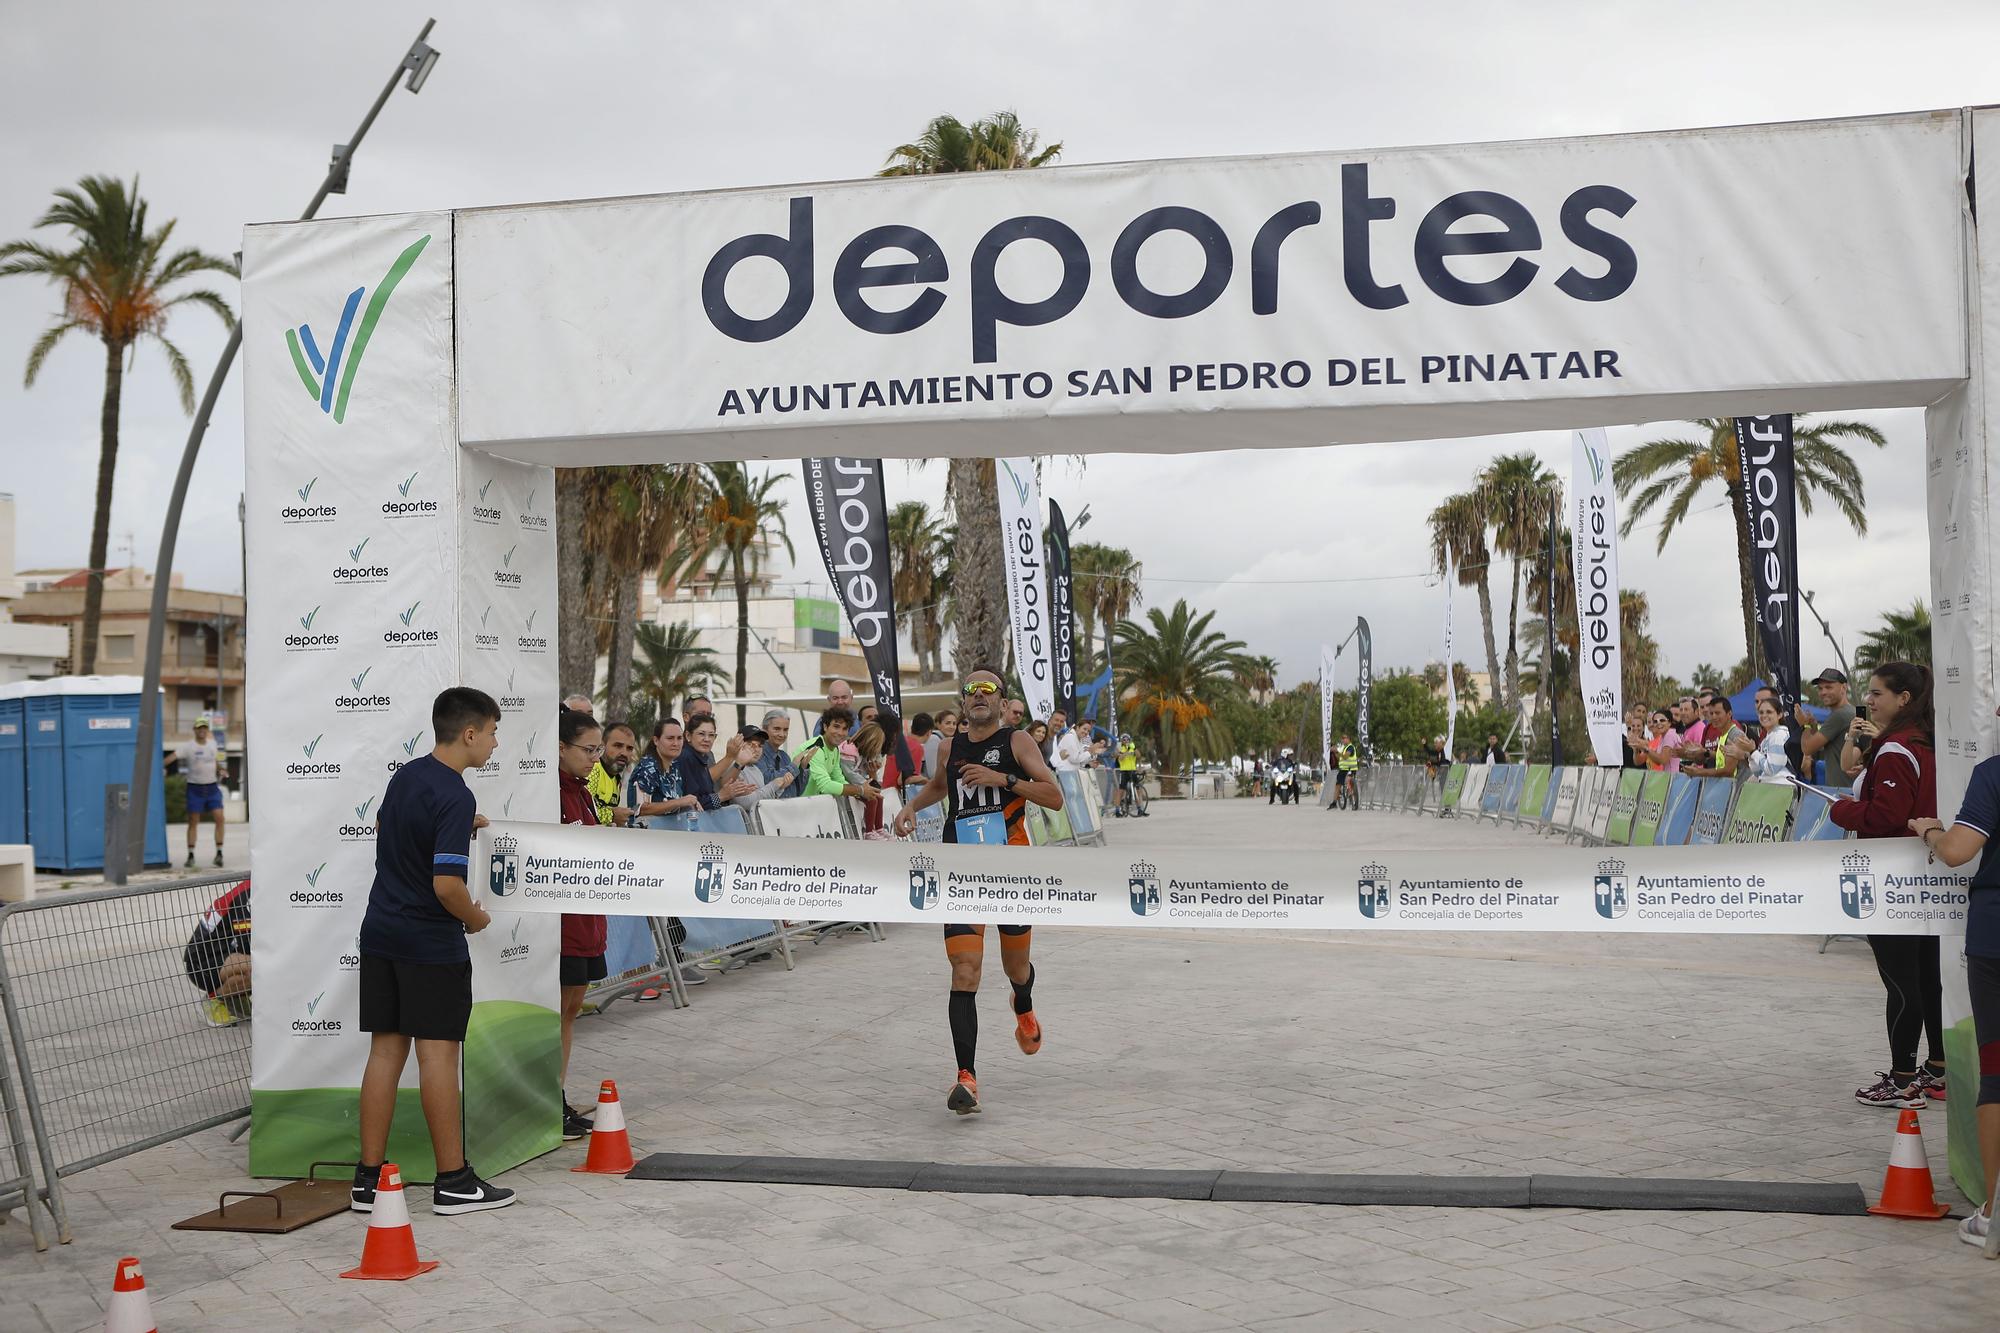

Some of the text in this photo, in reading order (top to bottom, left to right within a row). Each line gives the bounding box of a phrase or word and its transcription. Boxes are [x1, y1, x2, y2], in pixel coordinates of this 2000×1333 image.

[701, 163, 1638, 363] deportes
[717, 350, 1623, 416] AYUNTAMIENTO SAN PEDRO DEL PINATAR
[282, 505, 336, 519] deportes
[382, 500, 437, 515] deportes
[473, 505, 501, 519] deportes
[520, 513, 547, 526] deportes
[333, 565, 388, 580] deportes
[494, 570, 522, 585] deportes
[284, 634, 339, 648] deportes
[384, 630, 438, 644] deportes
[518, 636, 547, 649] deportes
[335, 695, 390, 709] deportes
[500, 696, 525, 708] deportes
[286, 762, 341, 776] deportes
[518, 758, 547, 771] deportes
[977, 826, 984, 842] 1
[525, 856, 634, 870] Ayuntamiento de
[734, 863, 846, 878] Ayuntamiento de
[525, 872, 664, 887] San Pedro del Pinatar
[948, 871, 1062, 886] Ayuntamiento de
[1169, 879, 1289, 891] Ayuntamiento de
[1400, 878, 1523, 891] Ayuntamiento de
[1636, 875, 1765, 891] Ayuntamiento de
[732, 879, 878, 895] San Pedro del Pinatar
[948, 886, 1097, 902] San Pedro del Pinatar
[290, 890, 343, 904] deportes
[574, 890, 585, 899] de
[589, 890, 631, 901] Deportes
[783, 896, 795, 906] de
[799, 896, 843, 908] Deportes
[1170, 892, 1324, 905] San Pedro del Pinatar
[1400, 893, 1559, 905] San Pedro del Pinatar
[1637, 892, 1804, 904] San Pedro del Pinatar
[1886, 891, 1967, 904] San Pedro
[1001, 903, 1013, 913] de
[1017, 904, 1062, 915] Deportes
[1225, 909, 1239, 918] de
[1242, 909, 1289, 919] Deportes
[1458, 910, 1471, 919] de
[1474, 910, 1523, 920] Deportes
[1698, 909, 1712, 919] de
[1716, 909, 1767, 920] Deportes
[1949, 909, 1963, 919] de
[500, 943, 529, 957] deportes
[292, 1019, 341, 1033] deportes
